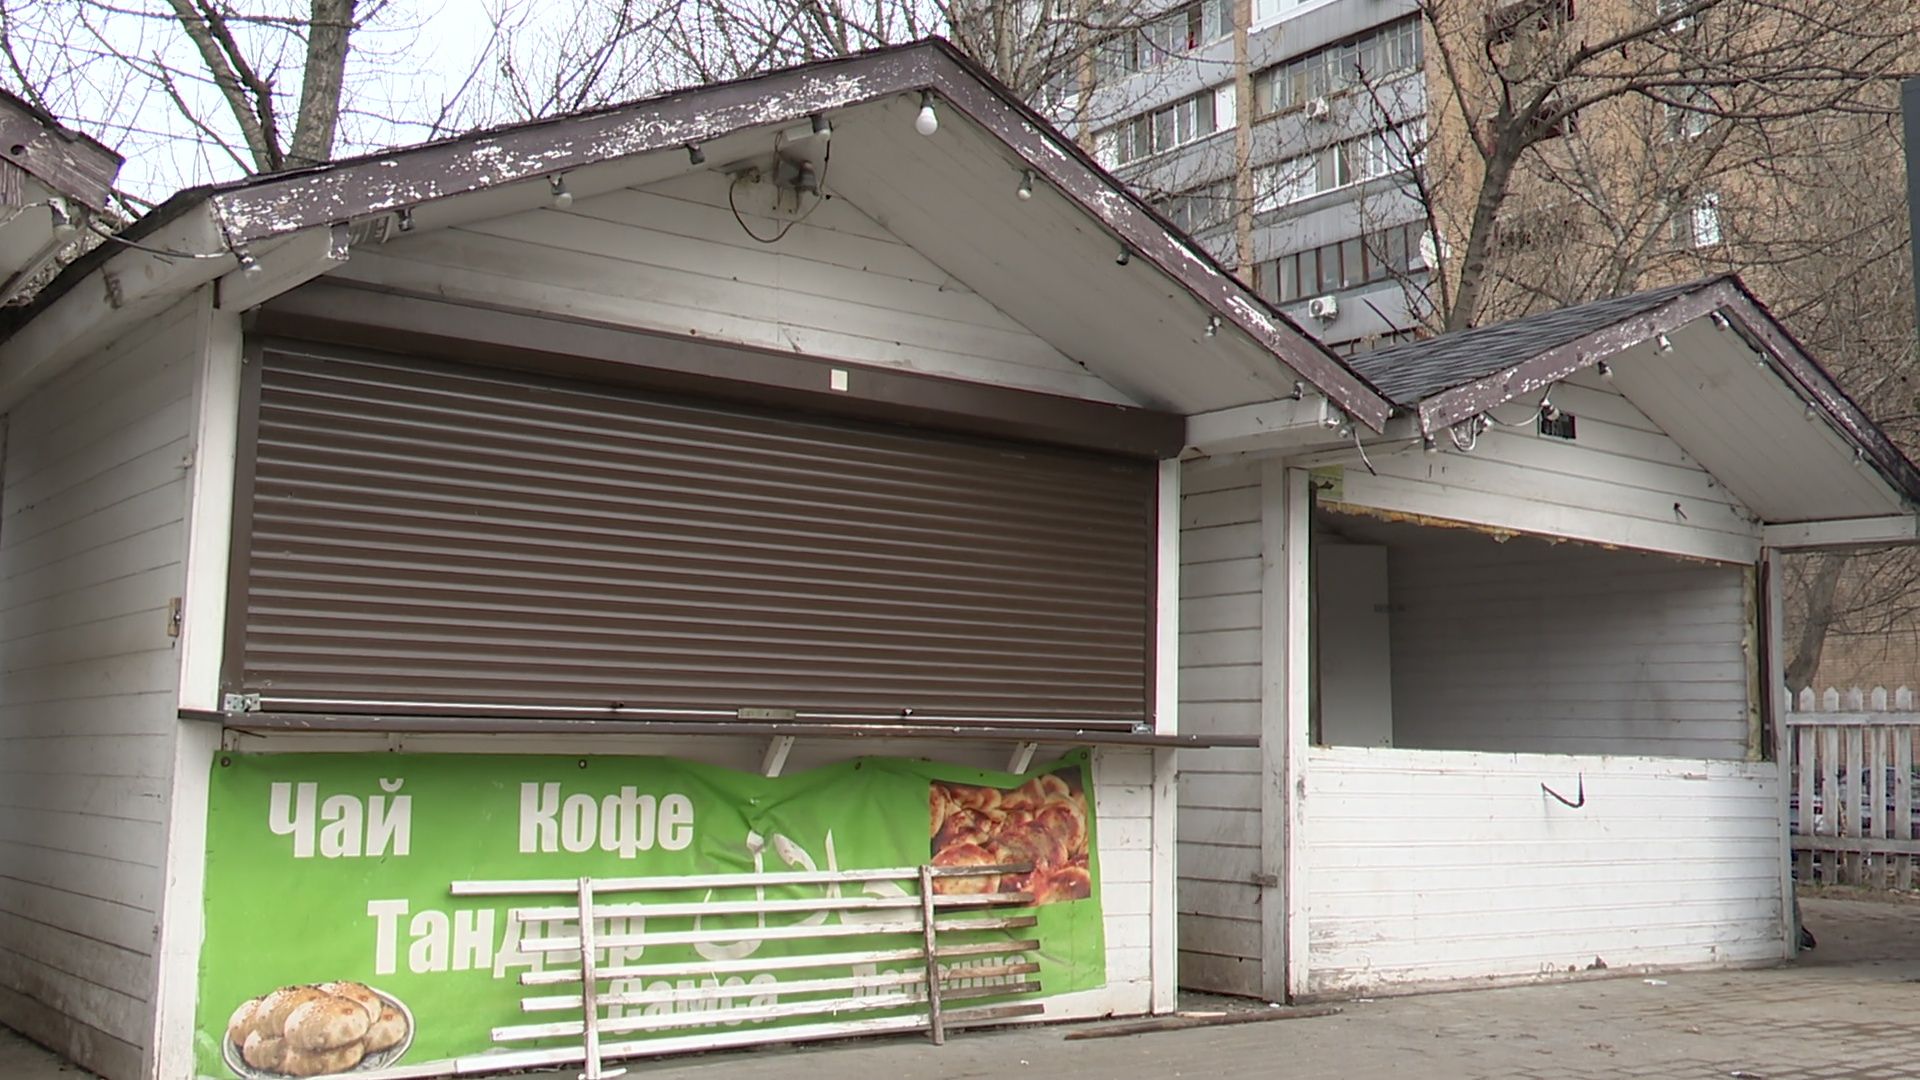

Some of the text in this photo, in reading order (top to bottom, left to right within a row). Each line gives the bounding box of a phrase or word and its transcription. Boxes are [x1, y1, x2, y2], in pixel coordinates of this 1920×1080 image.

[269, 778, 695, 859] Чай Кофе
[367, 899, 645, 979] Тандыр
